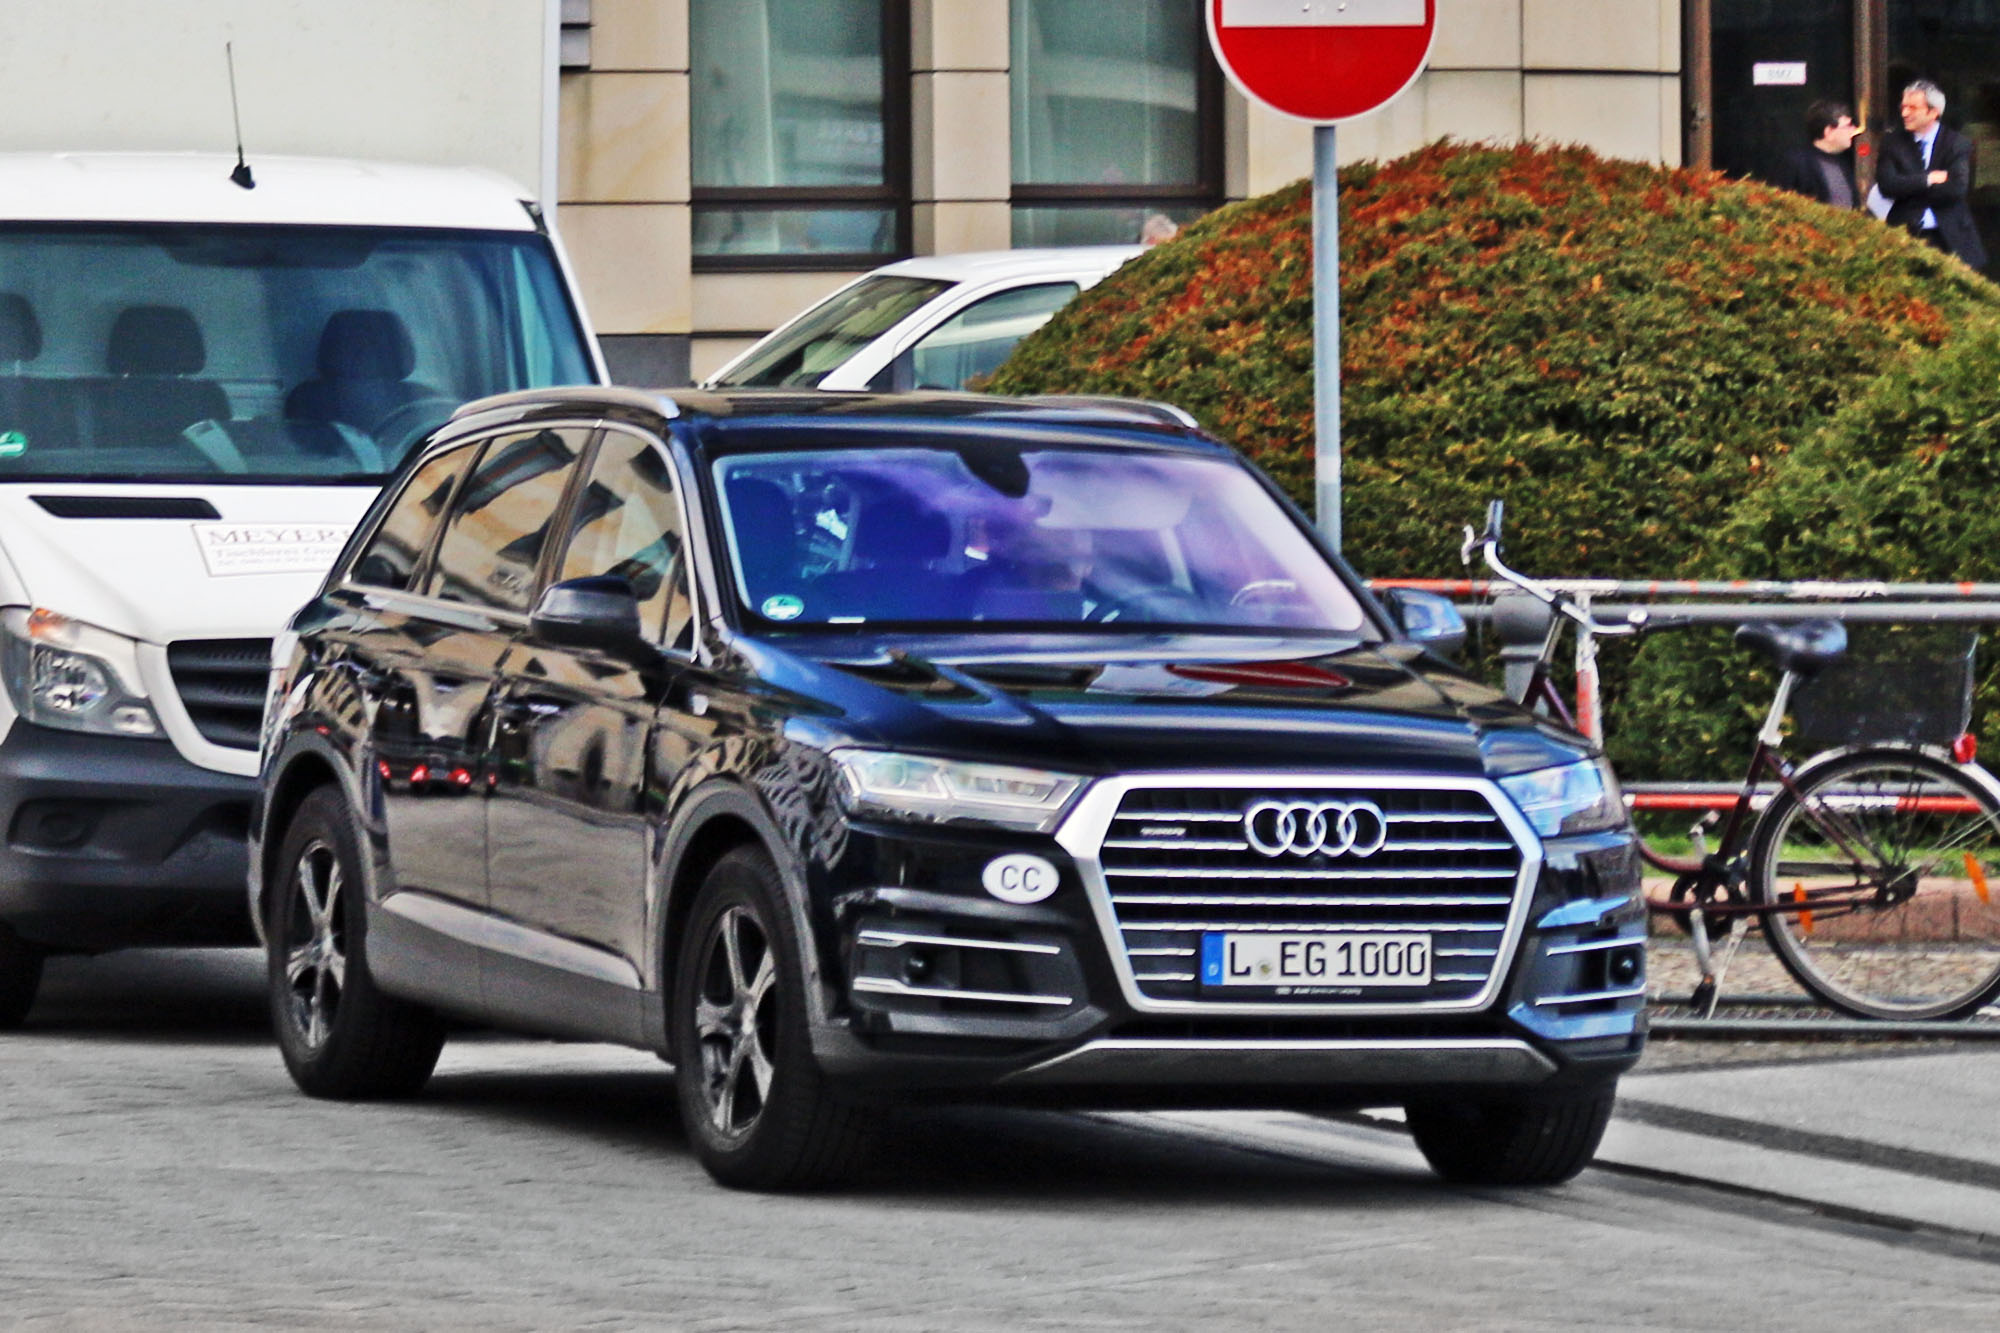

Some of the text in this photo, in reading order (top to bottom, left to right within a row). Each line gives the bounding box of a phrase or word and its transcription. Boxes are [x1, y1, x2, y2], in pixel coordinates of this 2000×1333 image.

[1001, 865, 1041, 892] CC
[1230, 941, 1426, 977] L EG 1000
